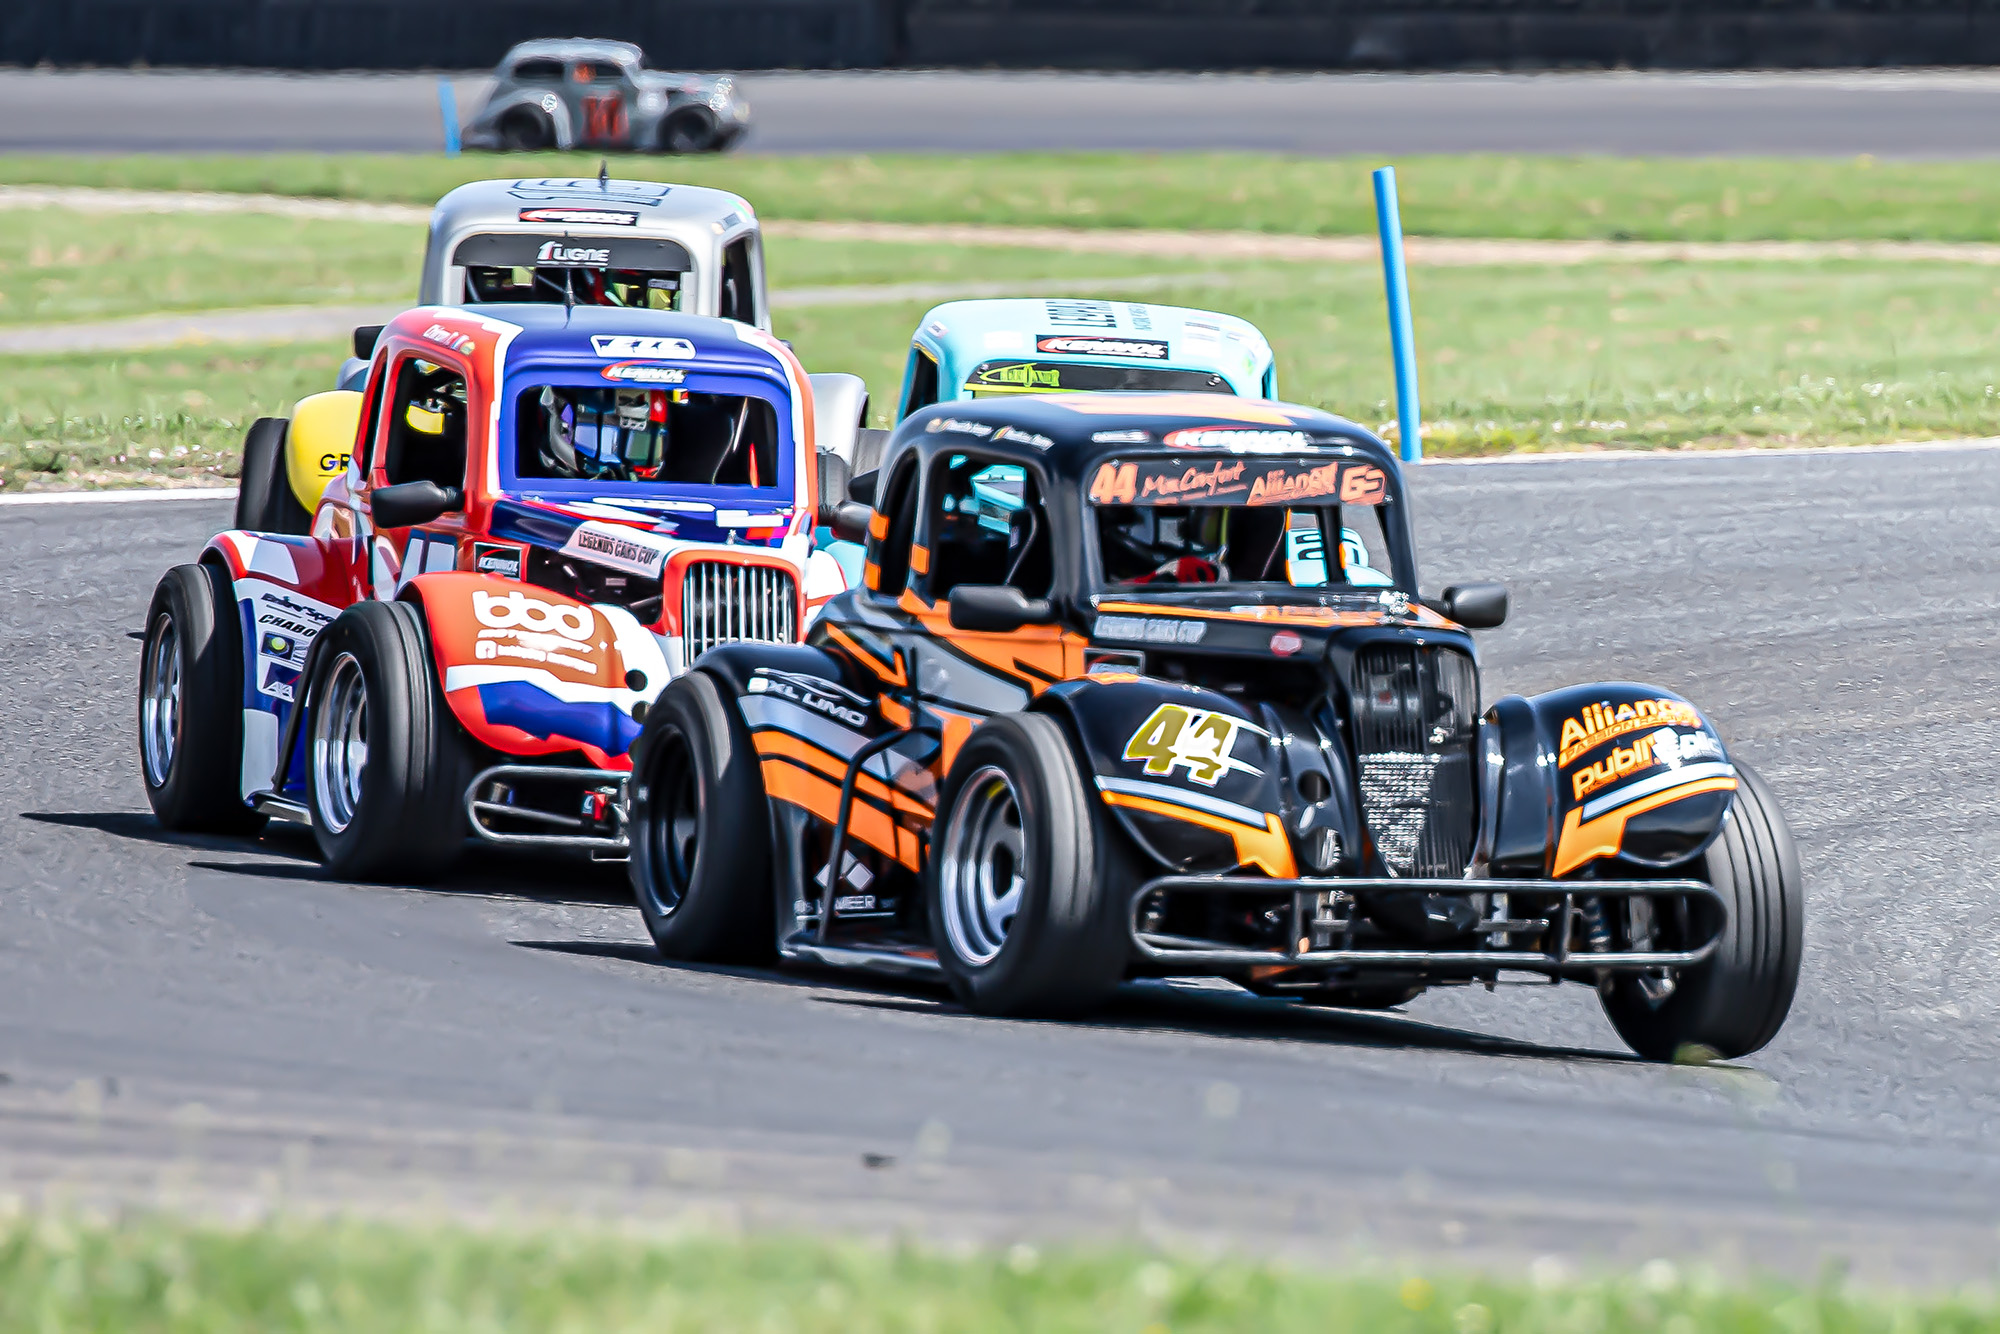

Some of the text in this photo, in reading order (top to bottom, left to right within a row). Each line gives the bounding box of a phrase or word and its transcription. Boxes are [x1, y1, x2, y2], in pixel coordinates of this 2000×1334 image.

[1089, 462, 1139, 504] 44
[802, 692, 868, 727] LIMO
[1124, 703, 1236, 786] 44
